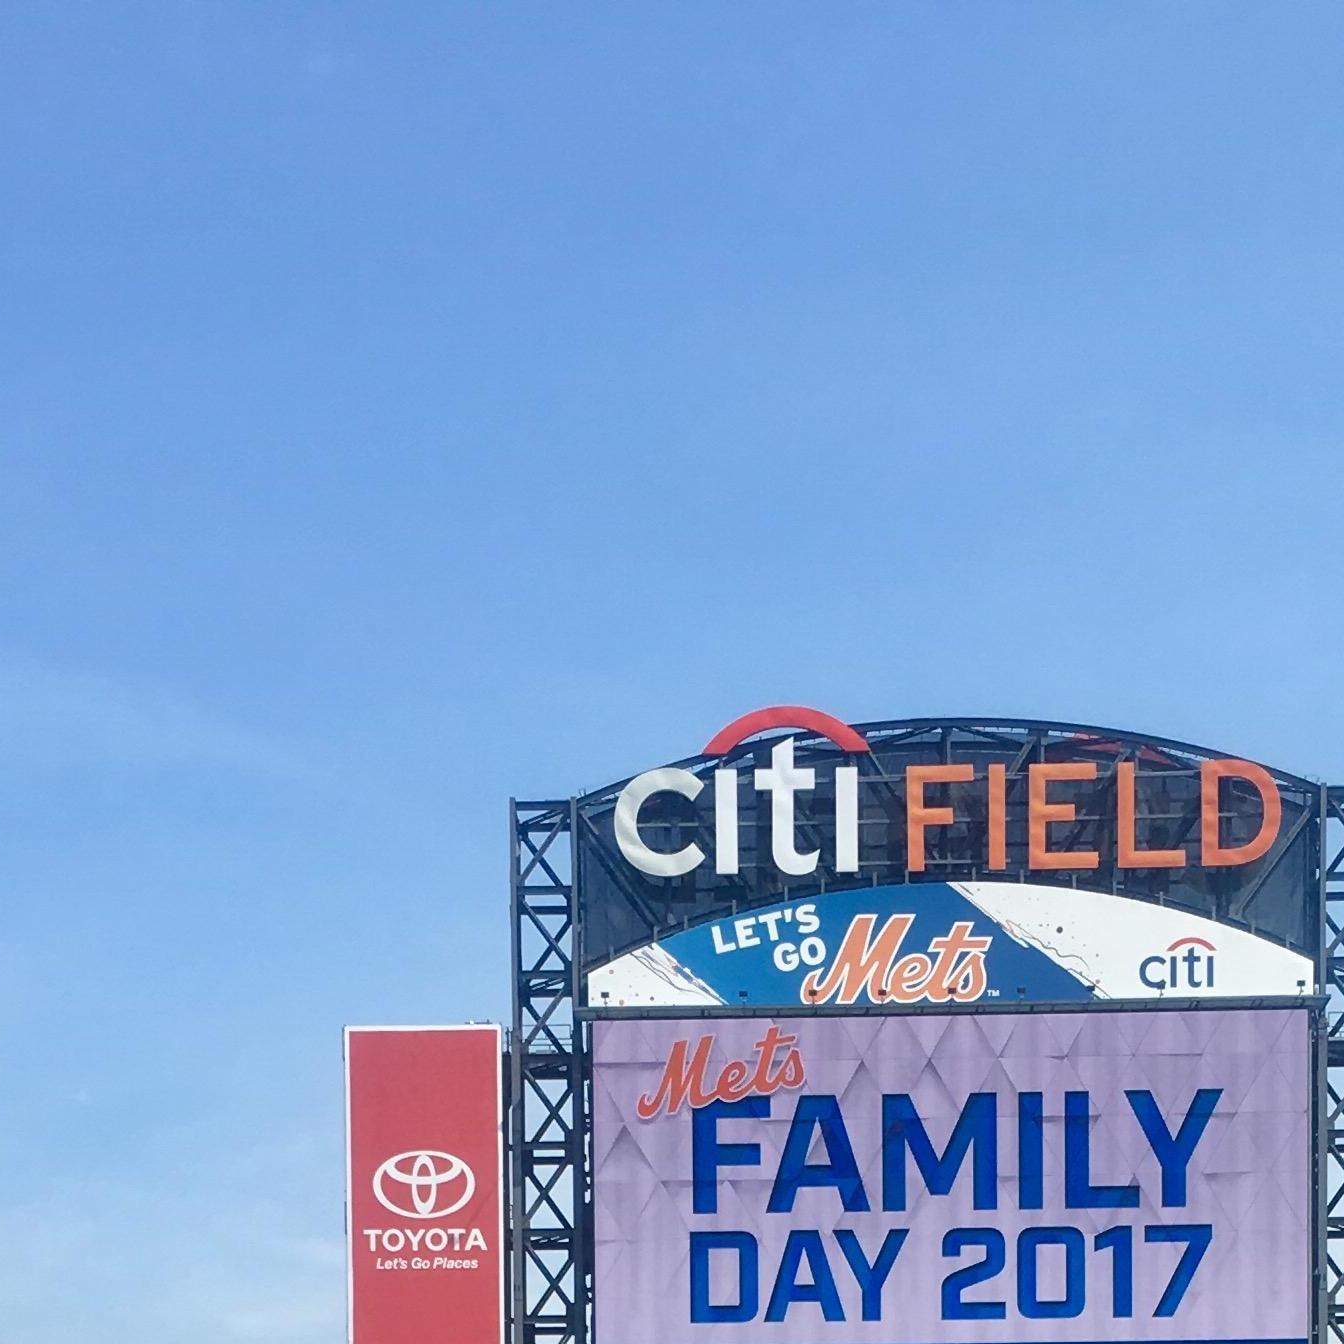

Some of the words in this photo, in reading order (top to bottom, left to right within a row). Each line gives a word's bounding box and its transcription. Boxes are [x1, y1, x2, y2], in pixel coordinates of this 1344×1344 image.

[614, 735, 859, 879] citi
[906, 759, 1283, 873] FIELD
[711, 903, 821, 955] LET'S
[773, 942, 826, 972] GO
[800, 912, 993, 1005] Mets
[1139, 947, 1215, 989] citi
[636, 1024, 807, 1122] Mets
[691, 1088, 1225, 1215] FAMILY
[363, 1228, 488, 1252] TOYOTA
[376, 1257, 408, 1270] Let's
[411, 1257, 430, 1270] Go
[433, 1257, 479, 1270] Places
[689, 1228, 910, 1323] DAY
[941, 1223, 1213, 1320] 2017
